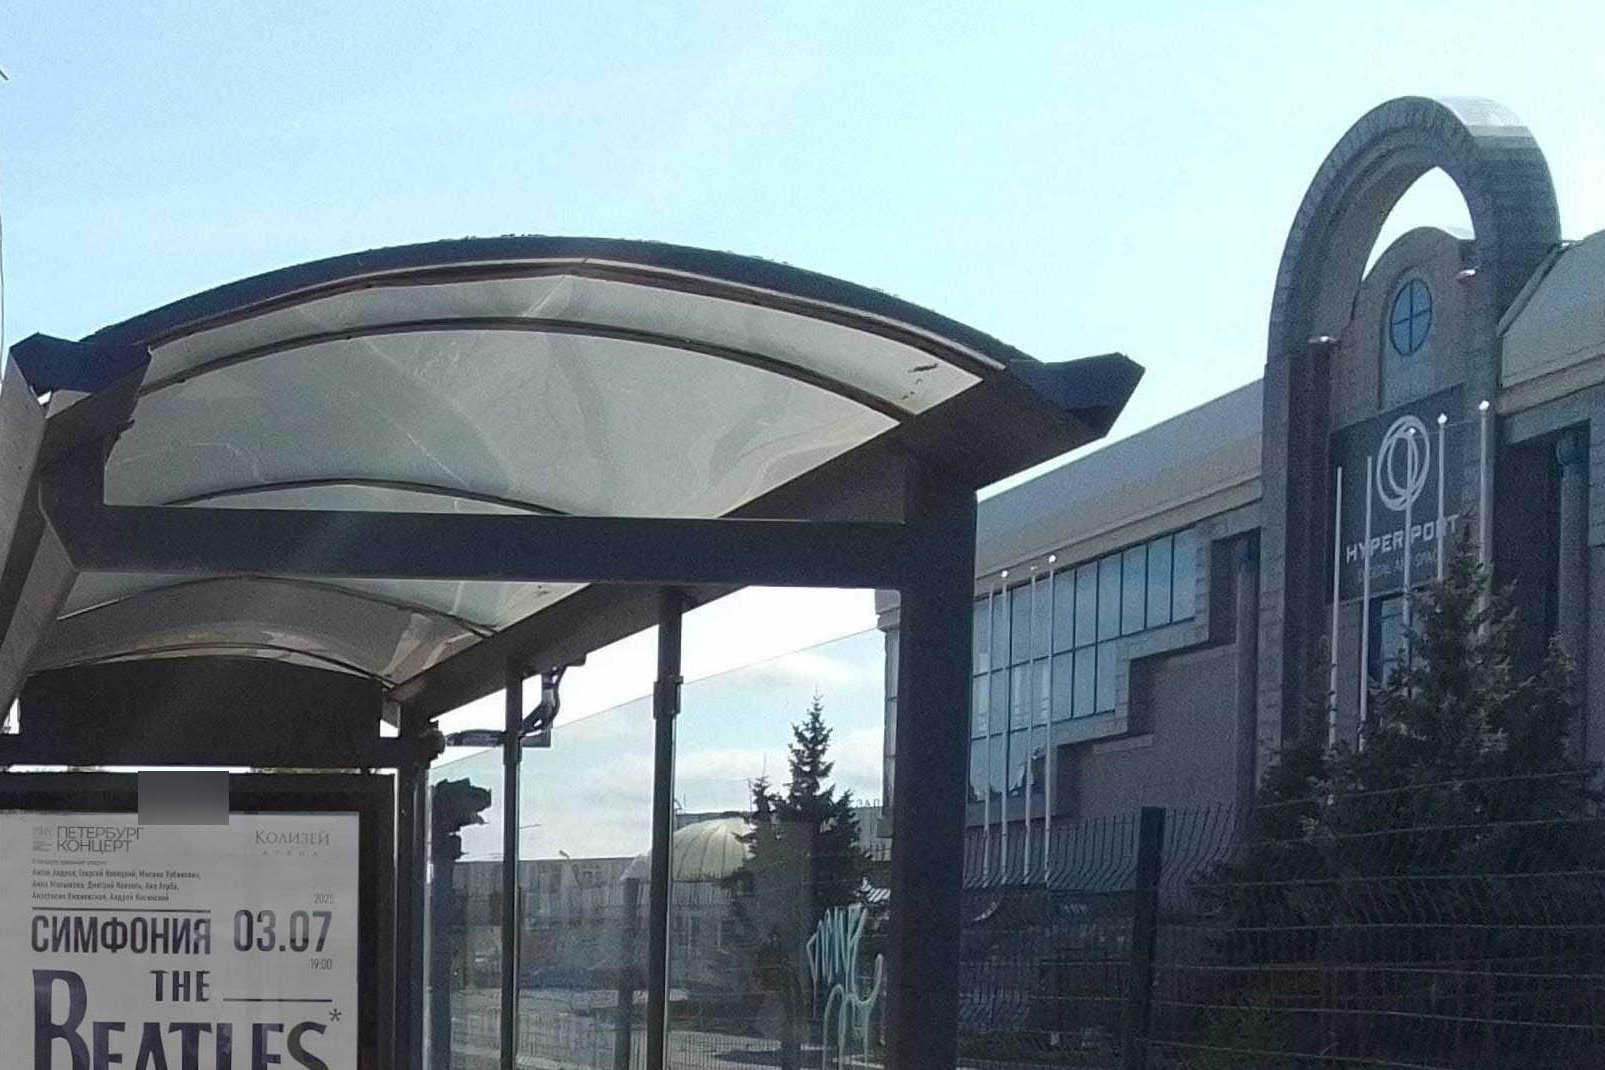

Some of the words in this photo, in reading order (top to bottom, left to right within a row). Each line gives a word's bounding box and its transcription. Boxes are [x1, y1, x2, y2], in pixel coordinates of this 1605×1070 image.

[57, 826, 144, 840] ПЕТЕРБУРГ
[57, 839, 132, 854] КОНЦЕРТ
[31, 915, 211, 955] СИМФОНИЯ
[234, 909, 332, 952] 03.07
[310, 958, 333, 970] 19:00
[150, 970, 211, 1002] THE
